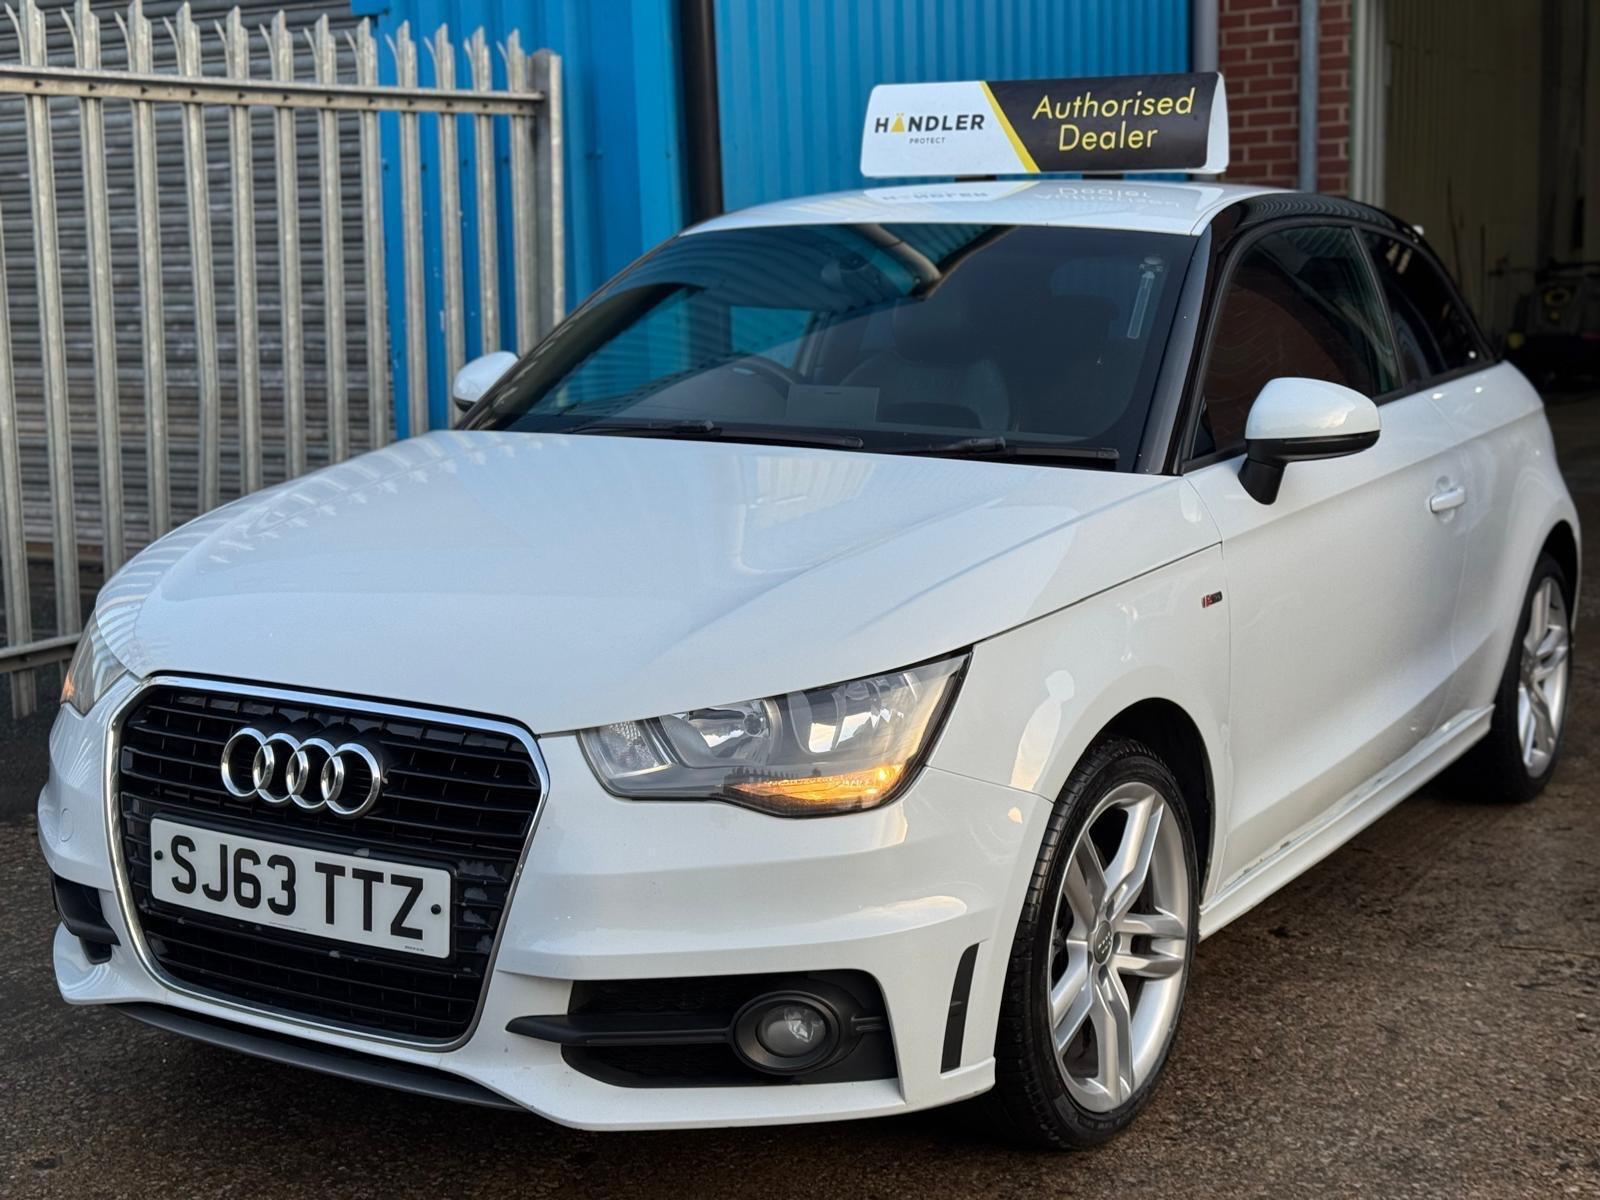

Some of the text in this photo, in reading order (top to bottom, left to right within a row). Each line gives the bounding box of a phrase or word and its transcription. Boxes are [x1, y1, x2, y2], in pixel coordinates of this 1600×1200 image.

[1032, 87, 1196, 120] Authorised
[874, 112, 985, 134] HÄNDLER
[1058, 123, 1158, 151] Dealer
[909, 137, 946, 145] PROTECT
[171, 835, 424, 940] SJ63 TTZ
